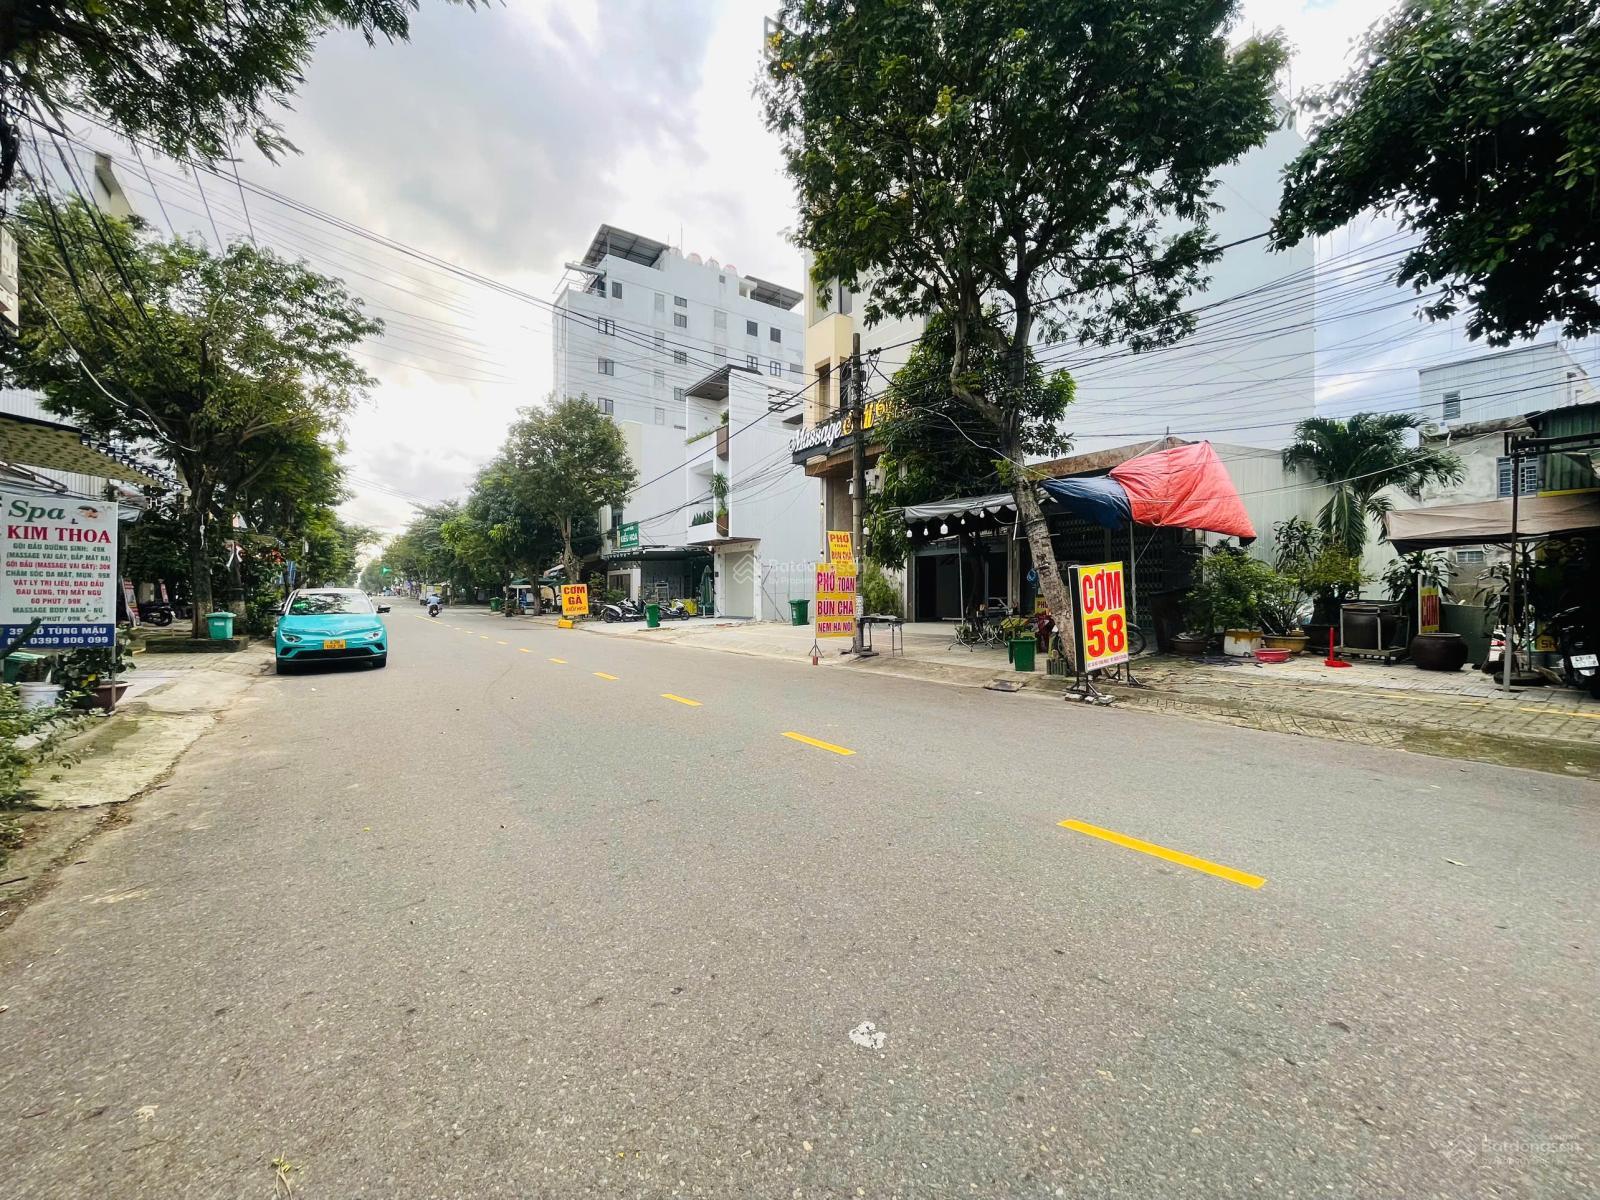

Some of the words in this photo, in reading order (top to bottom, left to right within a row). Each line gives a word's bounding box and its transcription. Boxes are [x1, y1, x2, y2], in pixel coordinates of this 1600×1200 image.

[788, 420, 841, 453] Massage
[8, 500, 65, 522] Spa
[7, 525, 48, 540] KIM
[55, 527, 112, 543] THOA
[564, 585, 586, 595] CƠM
[1082, 569, 1122, 615] CƠM
[568, 594, 583, 605] GÀ
[818, 622, 832, 632] NEM
[1086, 613, 1125, 658] 58
[30, 637, 59, 645] 0399
[87, 636, 109, 644] 099
